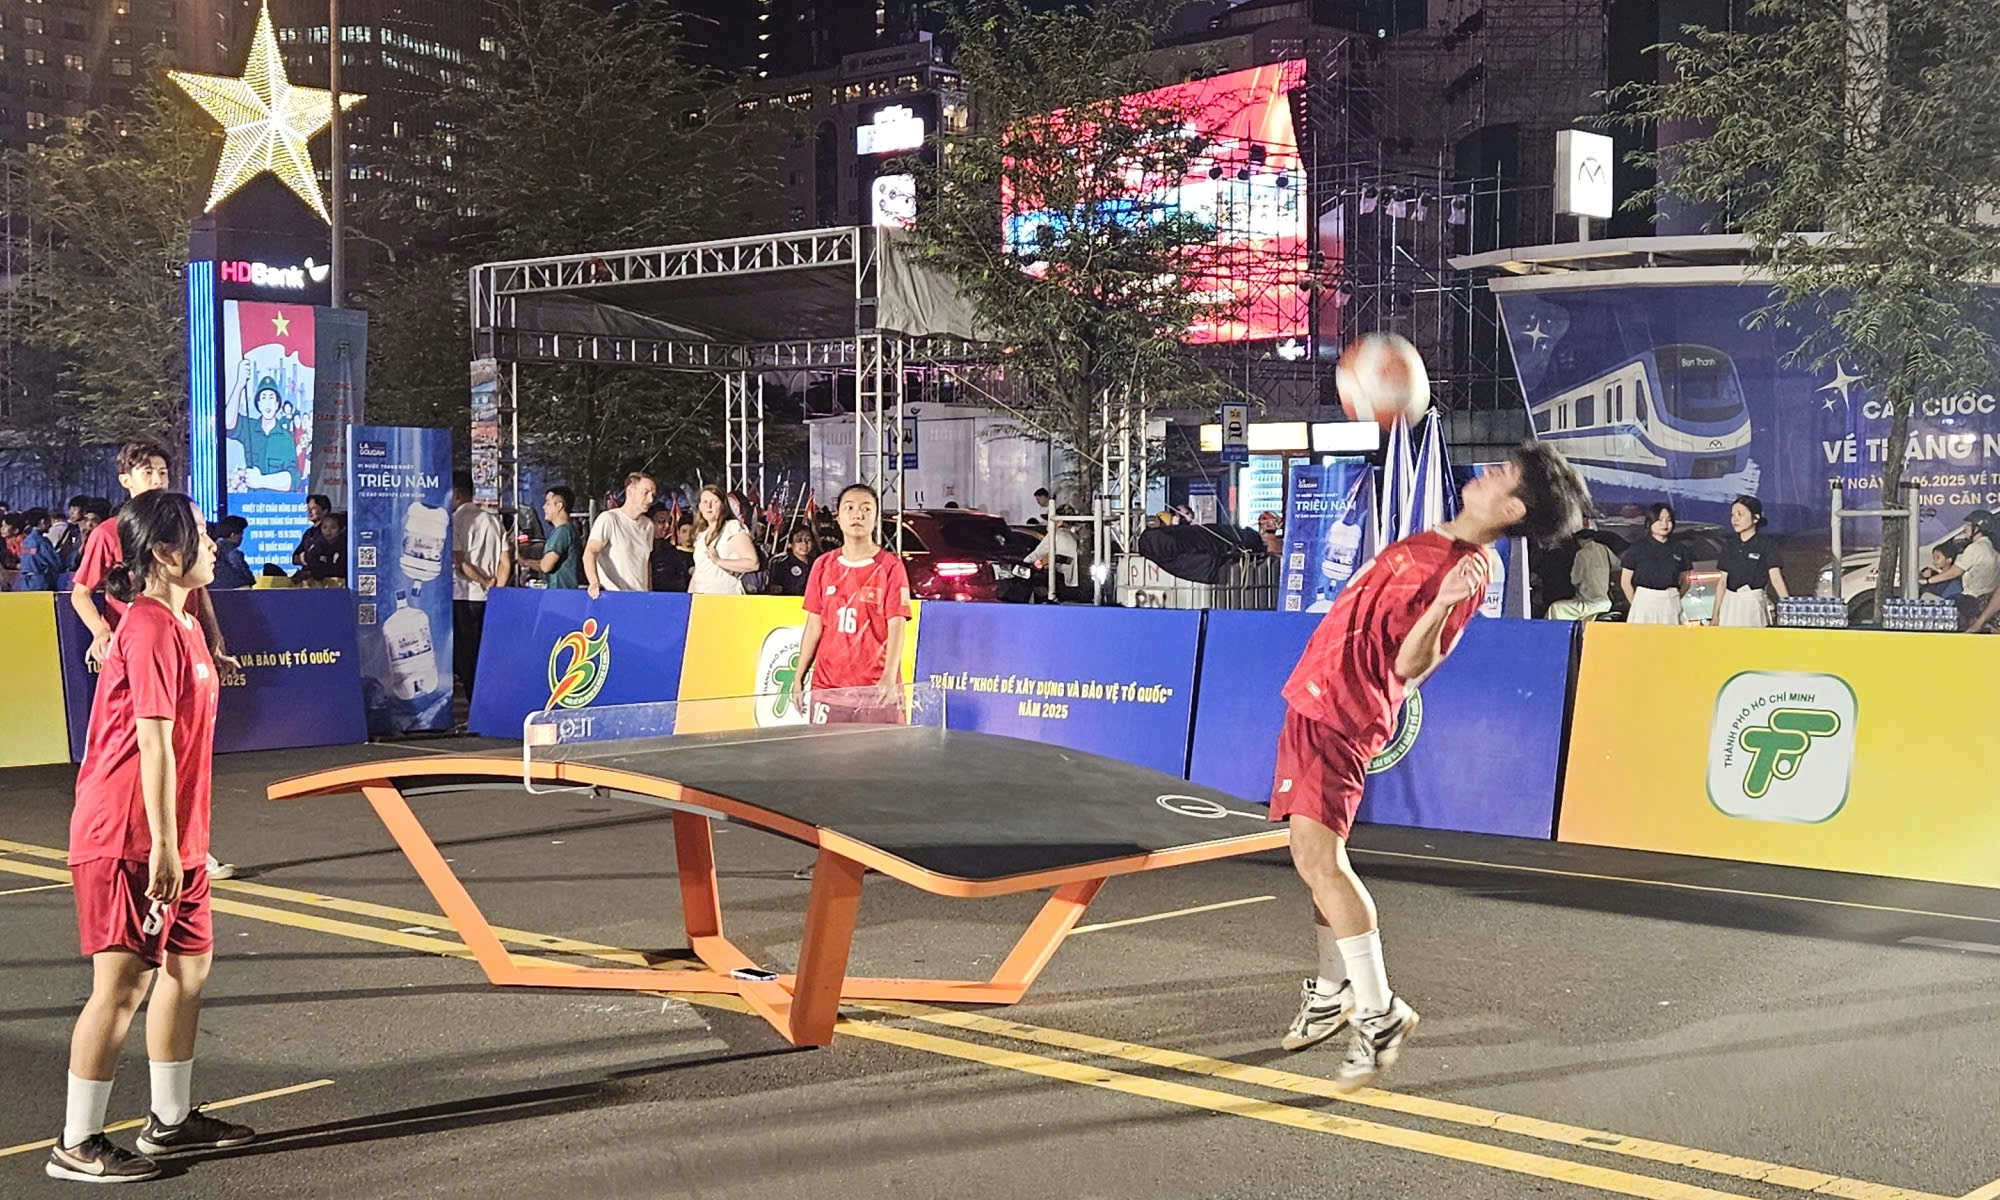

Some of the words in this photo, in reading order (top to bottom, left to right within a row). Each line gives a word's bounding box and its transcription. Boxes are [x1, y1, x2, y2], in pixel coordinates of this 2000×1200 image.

[220, 260, 305, 290] HDBank
[1822, 433, 1857, 464] VÉ
[358, 472, 401, 491] TRIỆU
[837, 607, 857, 634] 16
[278, 650, 292, 668] VỆ
[1016, 678, 1036, 695] XÂY
[1036, 680, 1064, 699] DỰNG
[1066, 680, 1080, 698] VÀ
[1082, 680, 1103, 699] BẢO
[1106, 682, 1119, 704] VỆ
[1121, 682, 1137, 702] TỔ
[1790, 694, 1816, 703] MINH
[813, 702, 830, 724] 16
[1018, 700, 1041, 716] NĂM
[1042, 704, 1069, 719] 2025
